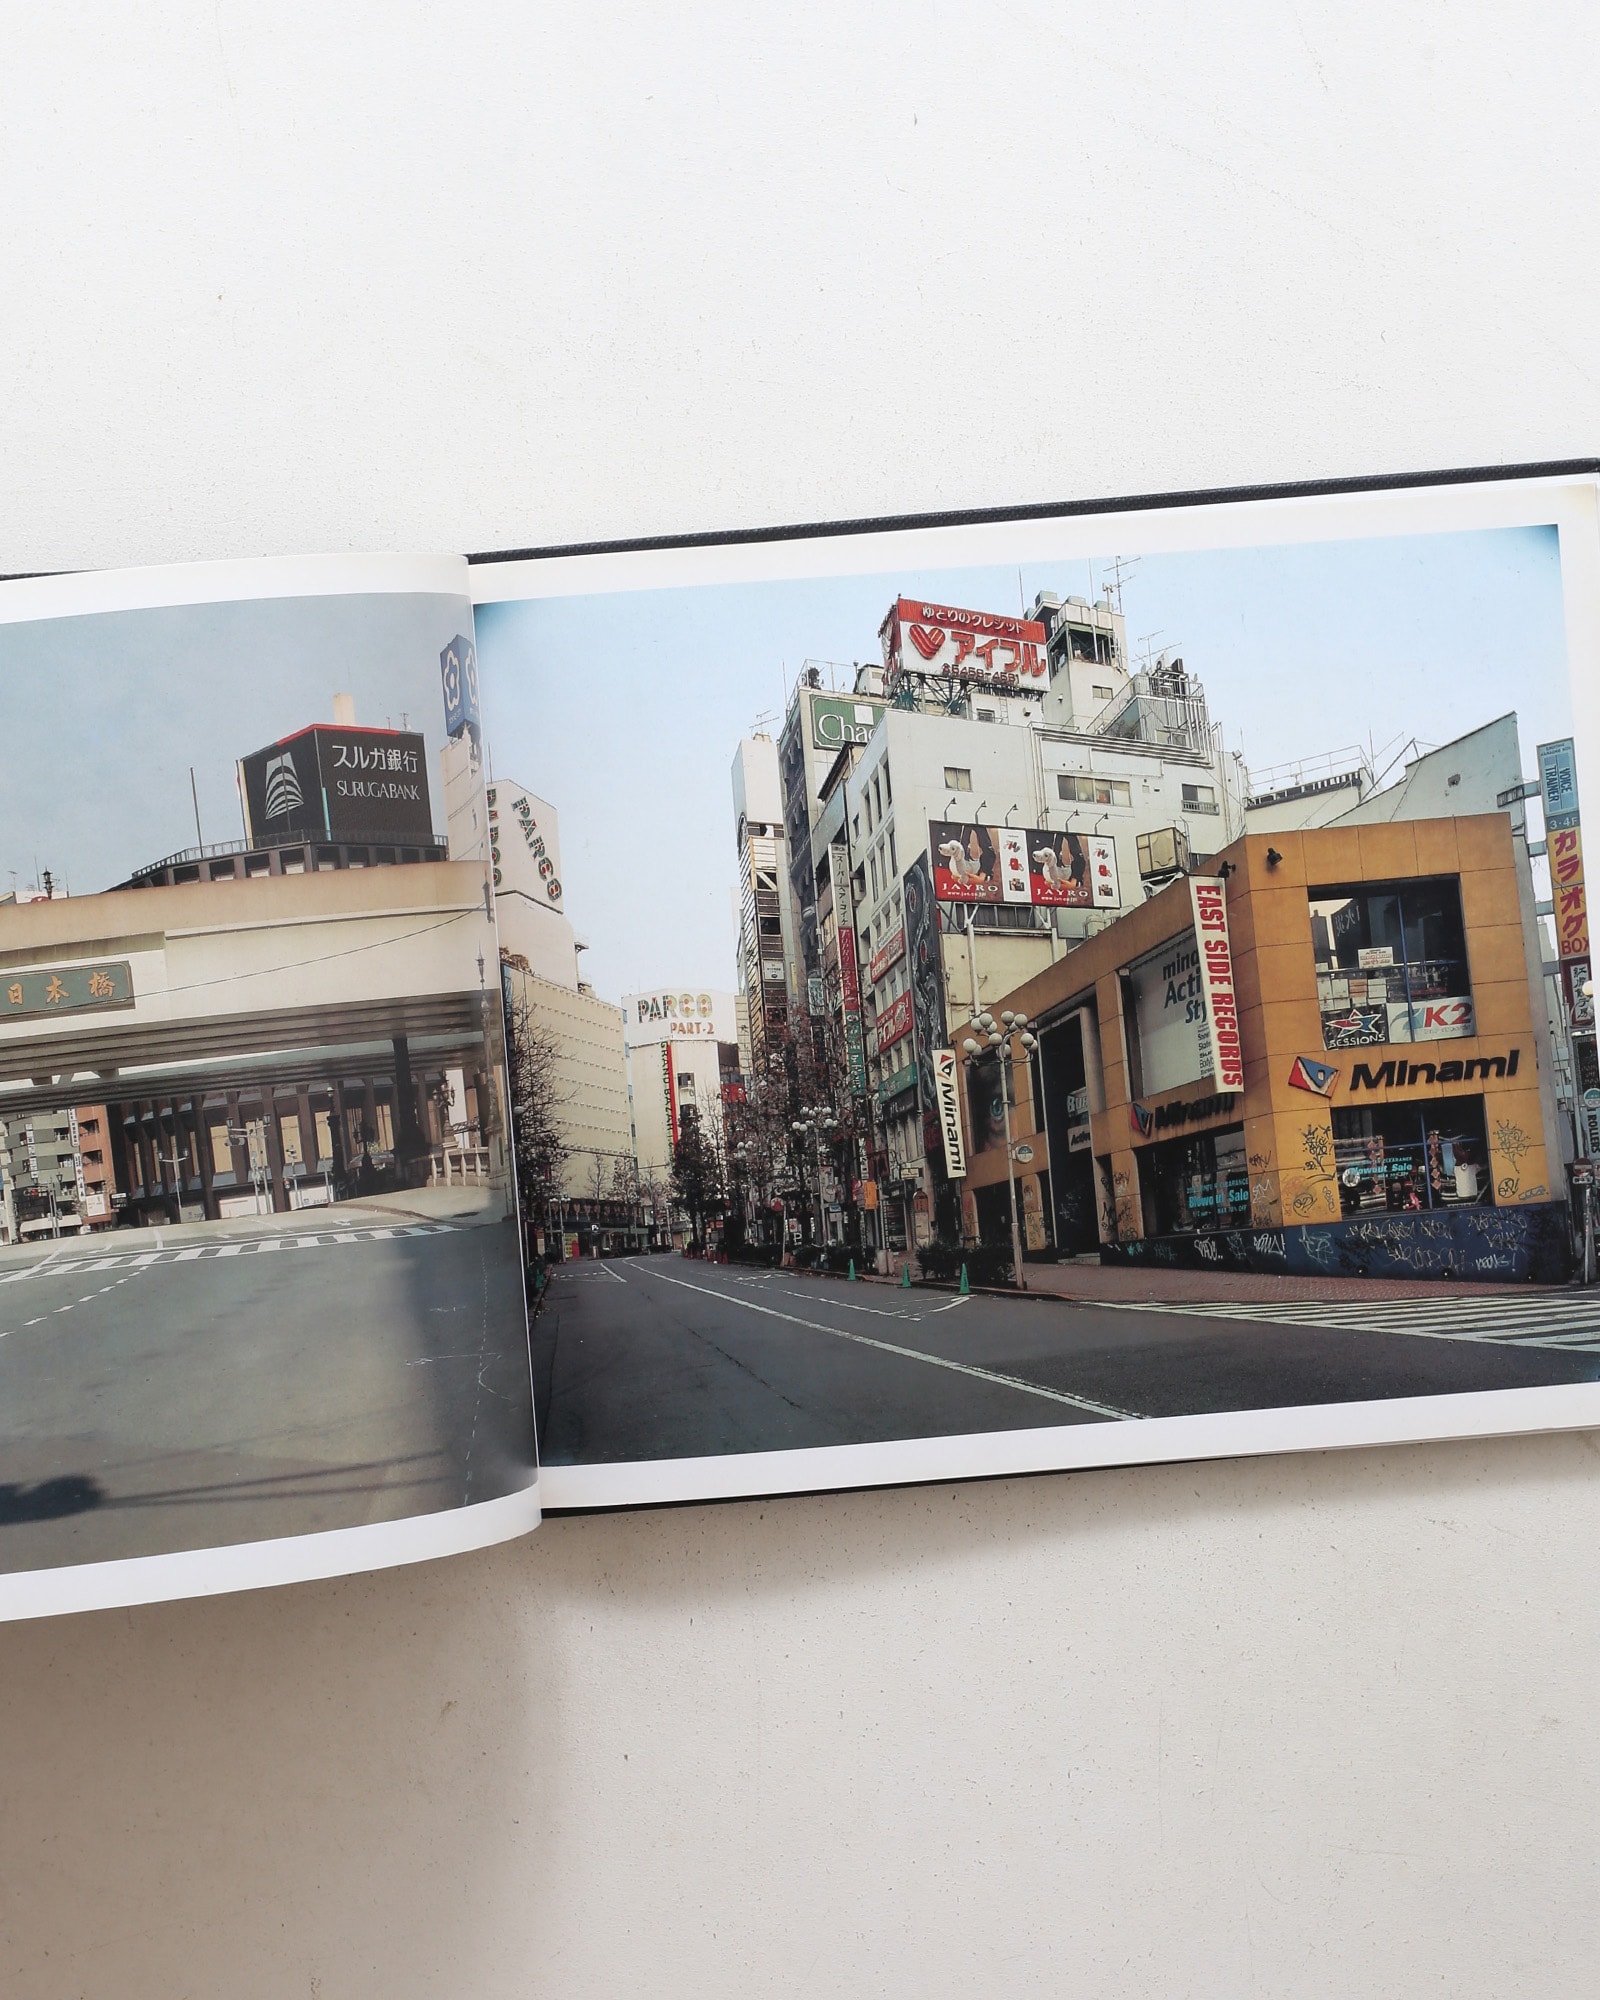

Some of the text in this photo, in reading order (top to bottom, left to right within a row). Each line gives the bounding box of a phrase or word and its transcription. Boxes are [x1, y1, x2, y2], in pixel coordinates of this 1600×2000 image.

[951, 631, 1046, 677] アイフル
[332, 745, 417, 773] スルガ銀行
[1545, 766, 1559, 802] TRAINER
[511, 796, 562, 902] PARCO
[943, 883, 998, 892] JAYRO
[1037, 889, 1088, 897] JAYRO
[1554, 830, 1586, 938] カラオケ
[8, 972, 116, 1005] 日本橋
[1196, 885, 1243, 1087] EAST SIDE RECORDS
[638, 994, 713, 1023] PARCO
[1424, 1002, 1473, 1028] K2
[1328, 1033, 1385, 1049] SESSIONS
[941, 1083, 965, 1171] Minami
[1392, 1163, 1412, 1172] Sale
[1229, 1188, 1249, 1202] Sale
